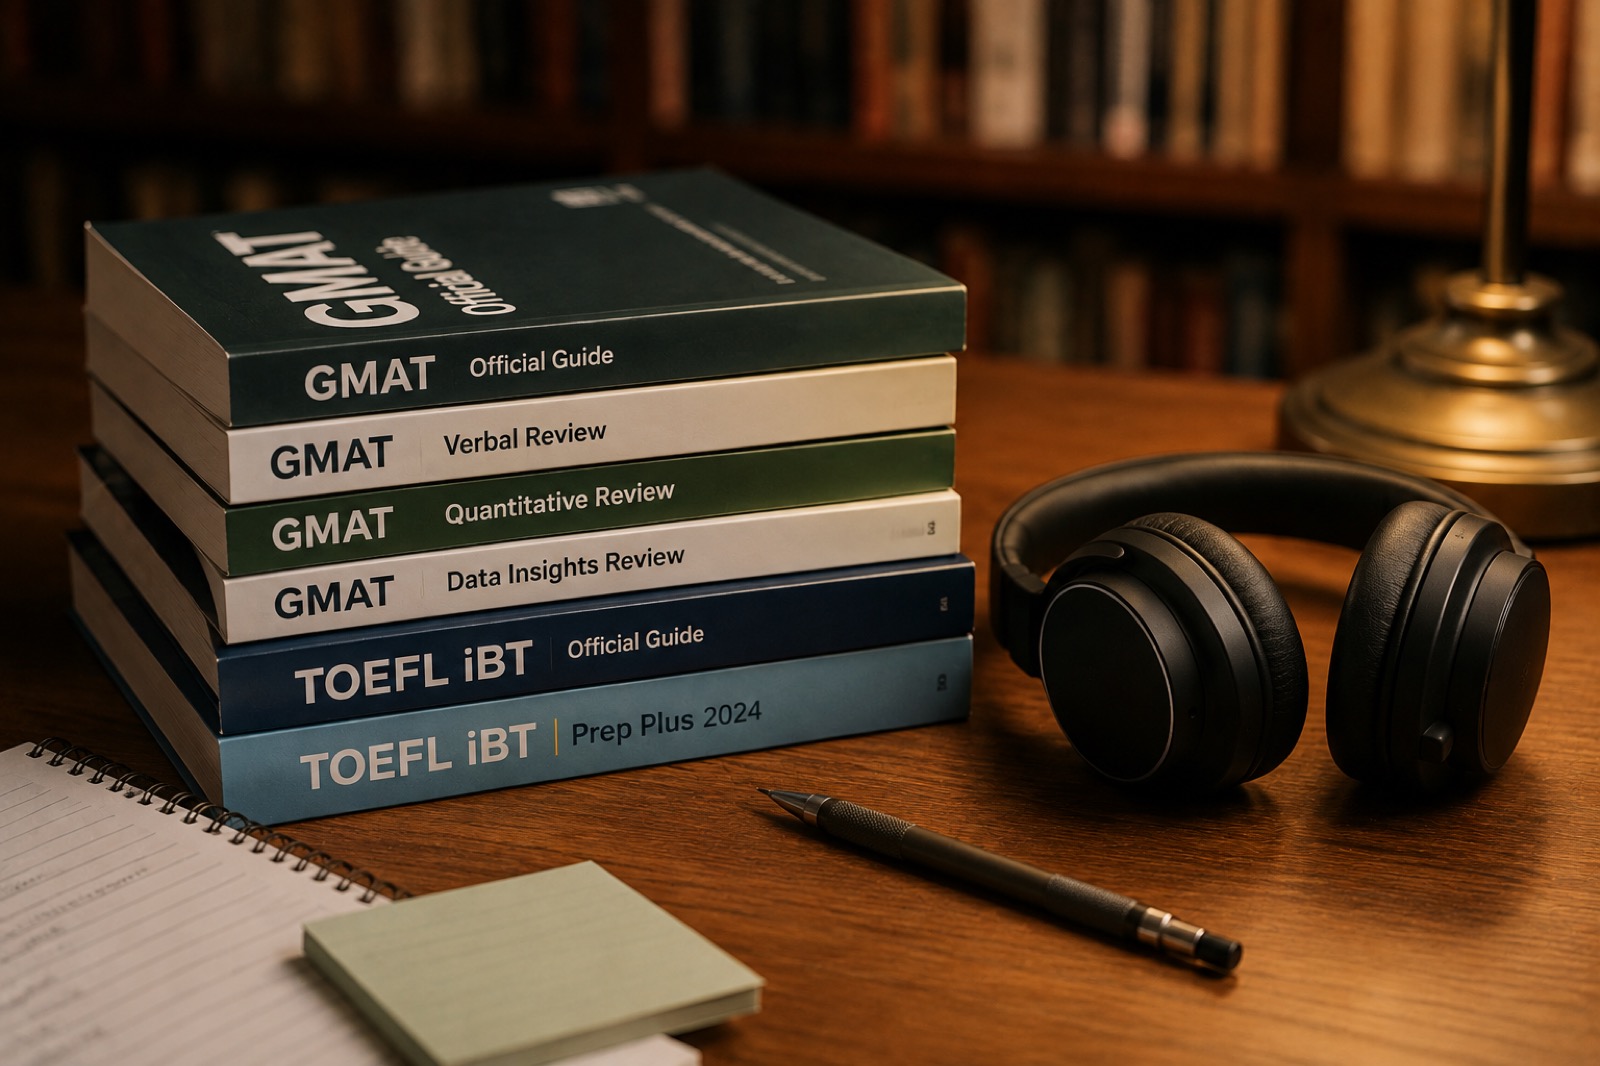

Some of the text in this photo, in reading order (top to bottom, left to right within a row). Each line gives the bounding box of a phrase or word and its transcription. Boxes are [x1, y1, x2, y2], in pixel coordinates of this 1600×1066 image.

[211, 230, 421, 328] GMAT
[413, 269, 517, 315] Official
[304, 345, 614, 401] GMAT Official Guide
[270, 422, 607, 480] GMAT Verbal Review
[272, 482, 675, 552] GMAT Quantitative Review
[274, 547, 685, 619] GMAT Data Insights Review
[294, 625, 704, 705] TOEFL iBT Official Guide
[299, 700, 763, 790] TOEFL iBT Prep Plus 2024
